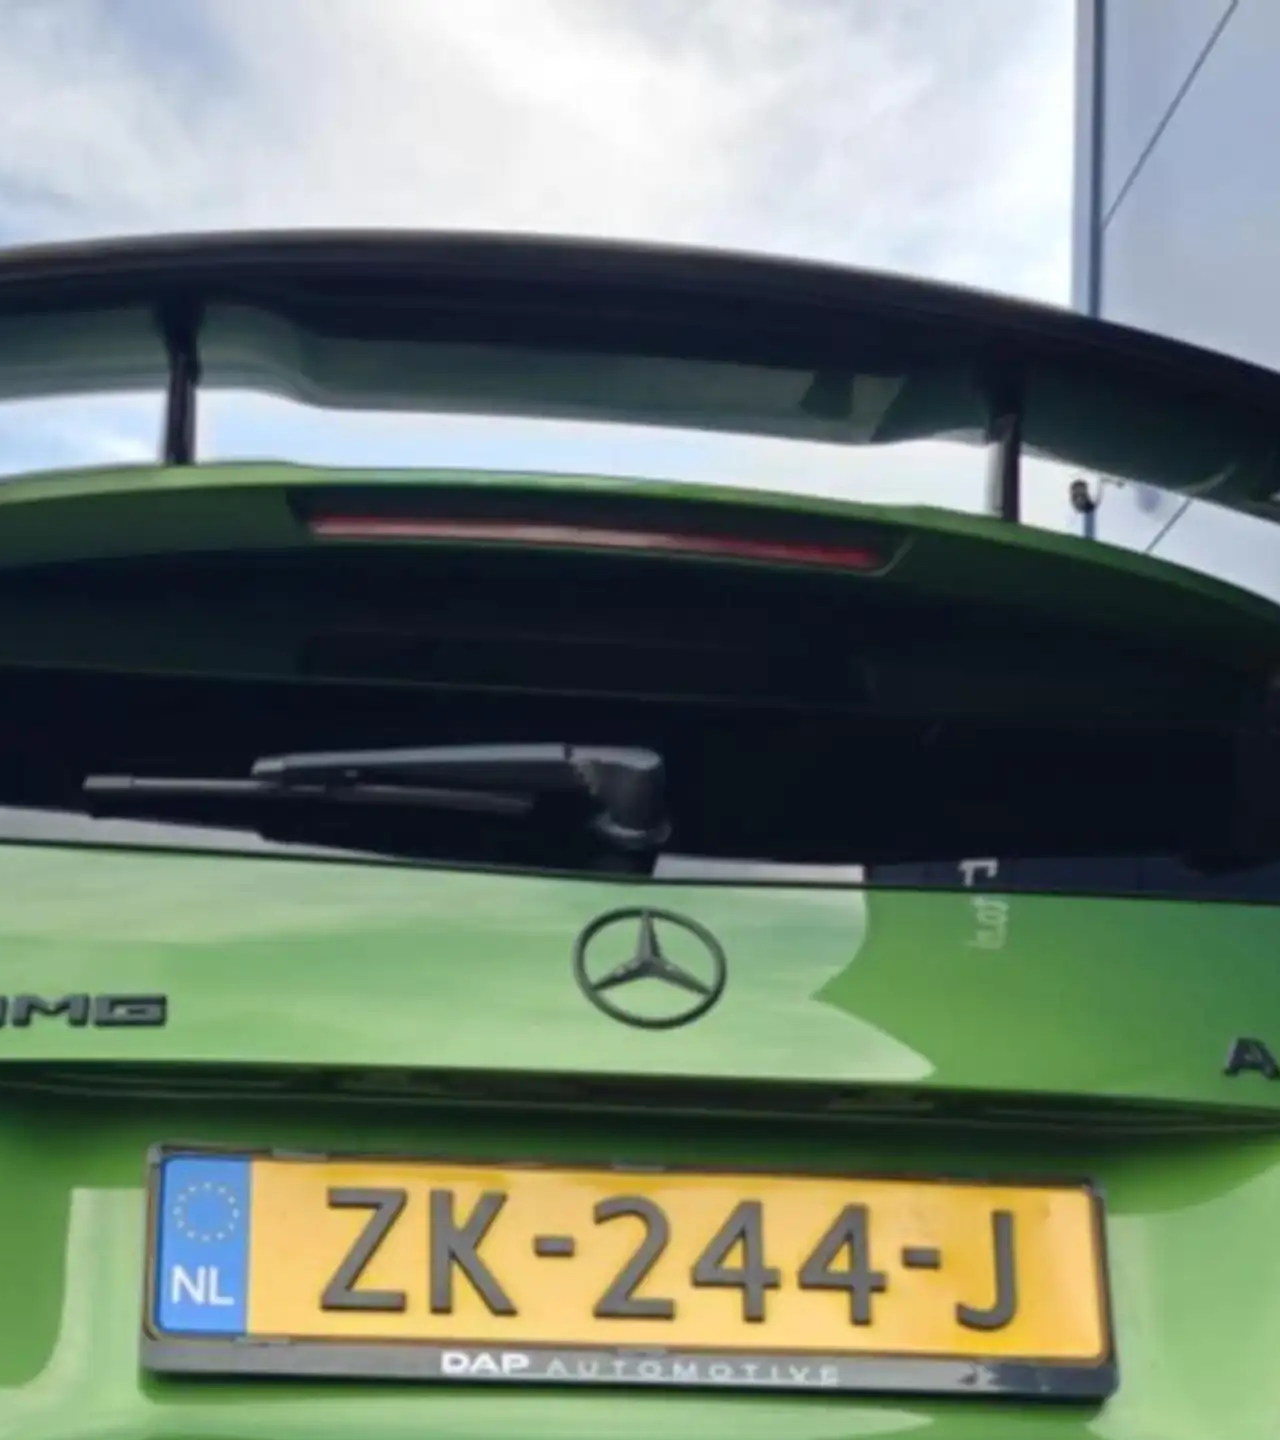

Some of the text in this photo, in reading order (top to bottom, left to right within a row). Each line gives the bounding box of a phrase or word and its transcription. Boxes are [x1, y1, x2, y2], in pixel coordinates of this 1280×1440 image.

[322, 1187, 1018, 1330] ZK-244-J
[172, 1264, 235, 1305] NL
[441, 1351, 841, 1385] DAP AUTOMOTIVE
